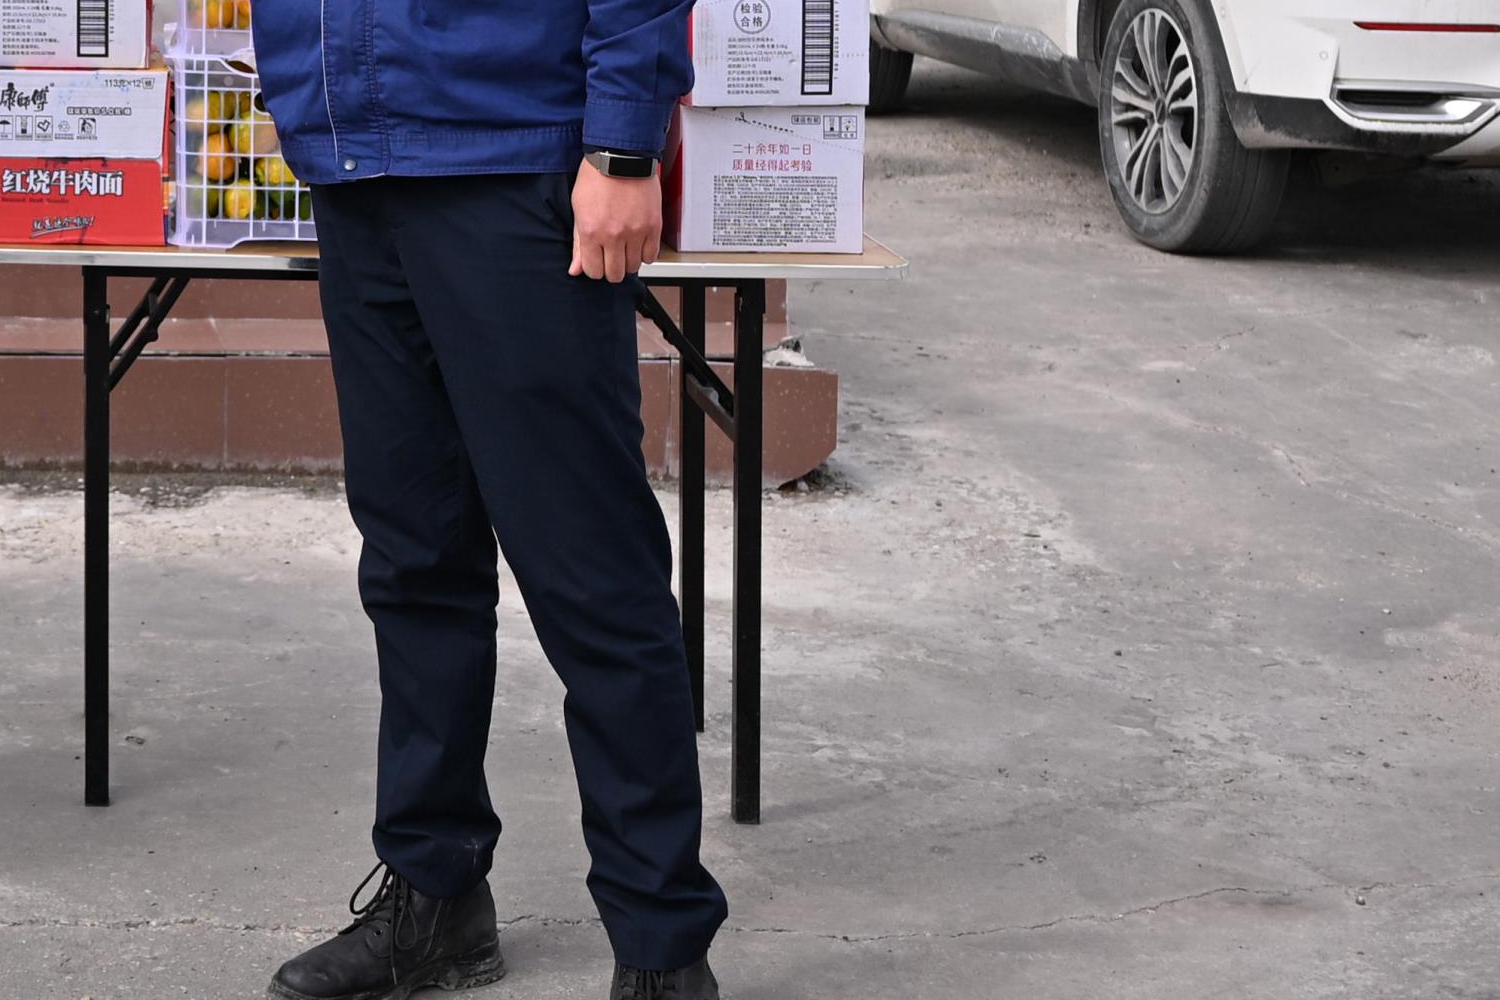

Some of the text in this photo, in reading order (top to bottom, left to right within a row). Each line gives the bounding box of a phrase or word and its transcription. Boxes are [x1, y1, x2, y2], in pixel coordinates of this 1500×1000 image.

[740, 3, 763, 14] 检验
[740, 16, 763, 28] 合格
[0, 82, 50, 112] 康師傅
[732, 143, 813, 155] 二十余年如一日
[732, 159, 813, 172] 质量经得起考验
[2, 168, 123, 196] 红烧牛肉面
